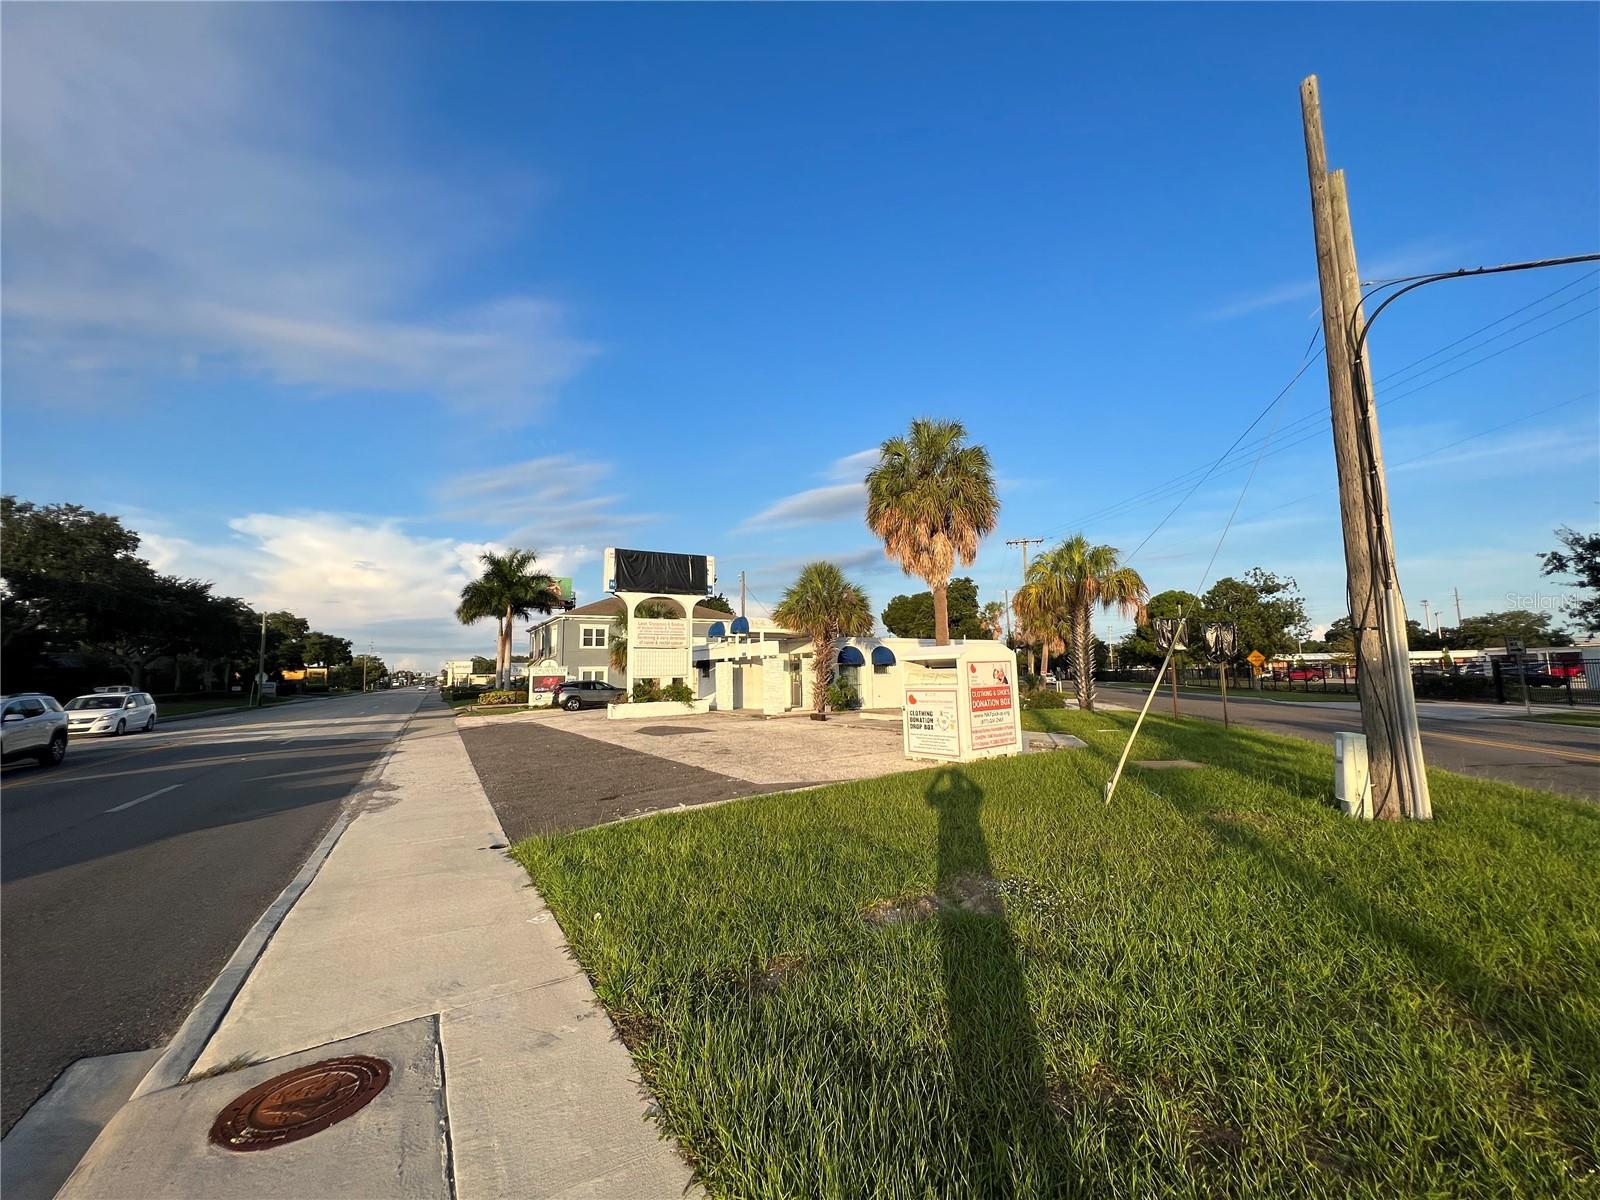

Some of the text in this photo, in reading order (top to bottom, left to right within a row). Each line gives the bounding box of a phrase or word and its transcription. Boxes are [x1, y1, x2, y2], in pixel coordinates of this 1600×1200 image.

[997, 688, 1010, 696] SHOES
[973, 698, 1011, 708] DONATION BOX
